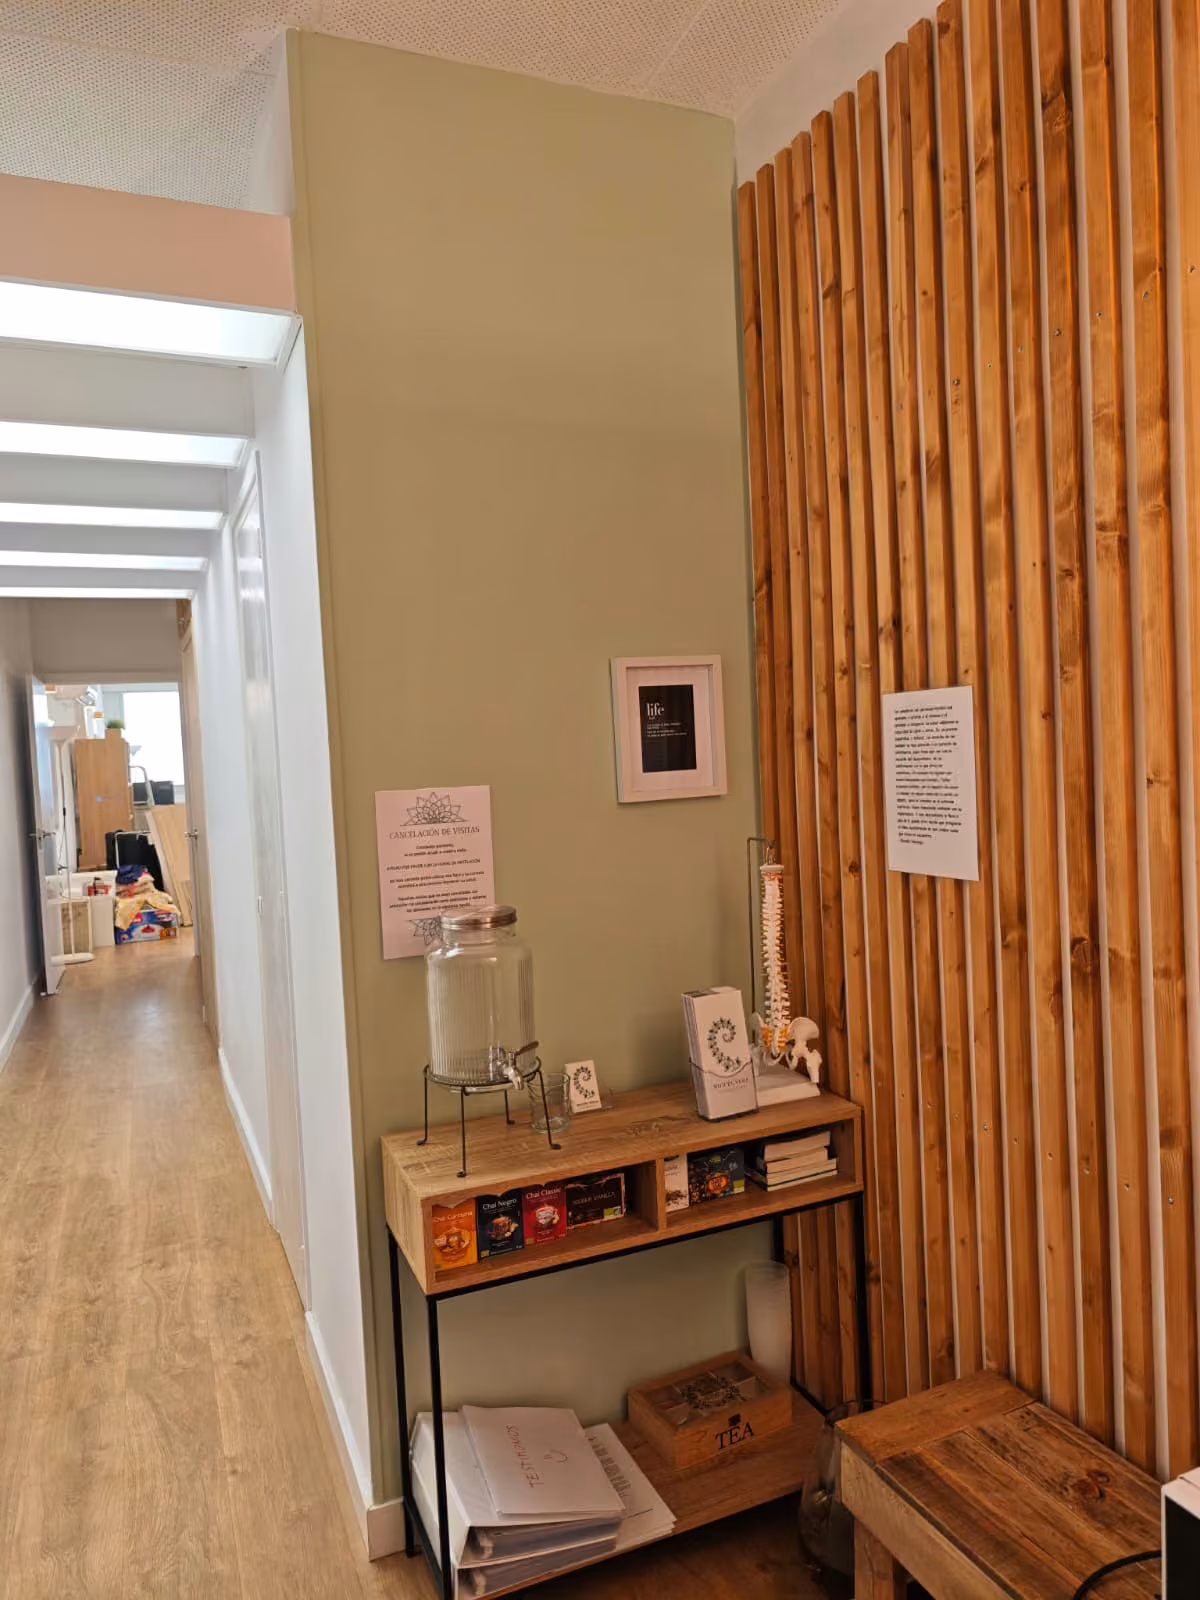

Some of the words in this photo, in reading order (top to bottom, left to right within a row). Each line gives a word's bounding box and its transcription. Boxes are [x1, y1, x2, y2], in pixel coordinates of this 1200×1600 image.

[646, 702, 665, 716] life
[389, 828, 440, 840] CANCELACIÓN
[441, 827, 453, 836] DE
[453, 826, 480, 835] VISITAS
[525, 1190, 540, 1200] Chai
[540, 1187, 562, 1198] Classic
[481, 1201, 497, 1211] Chai
[497, 1197, 518, 1210] Negro
[714, 1421, 755, 1450] TEA
